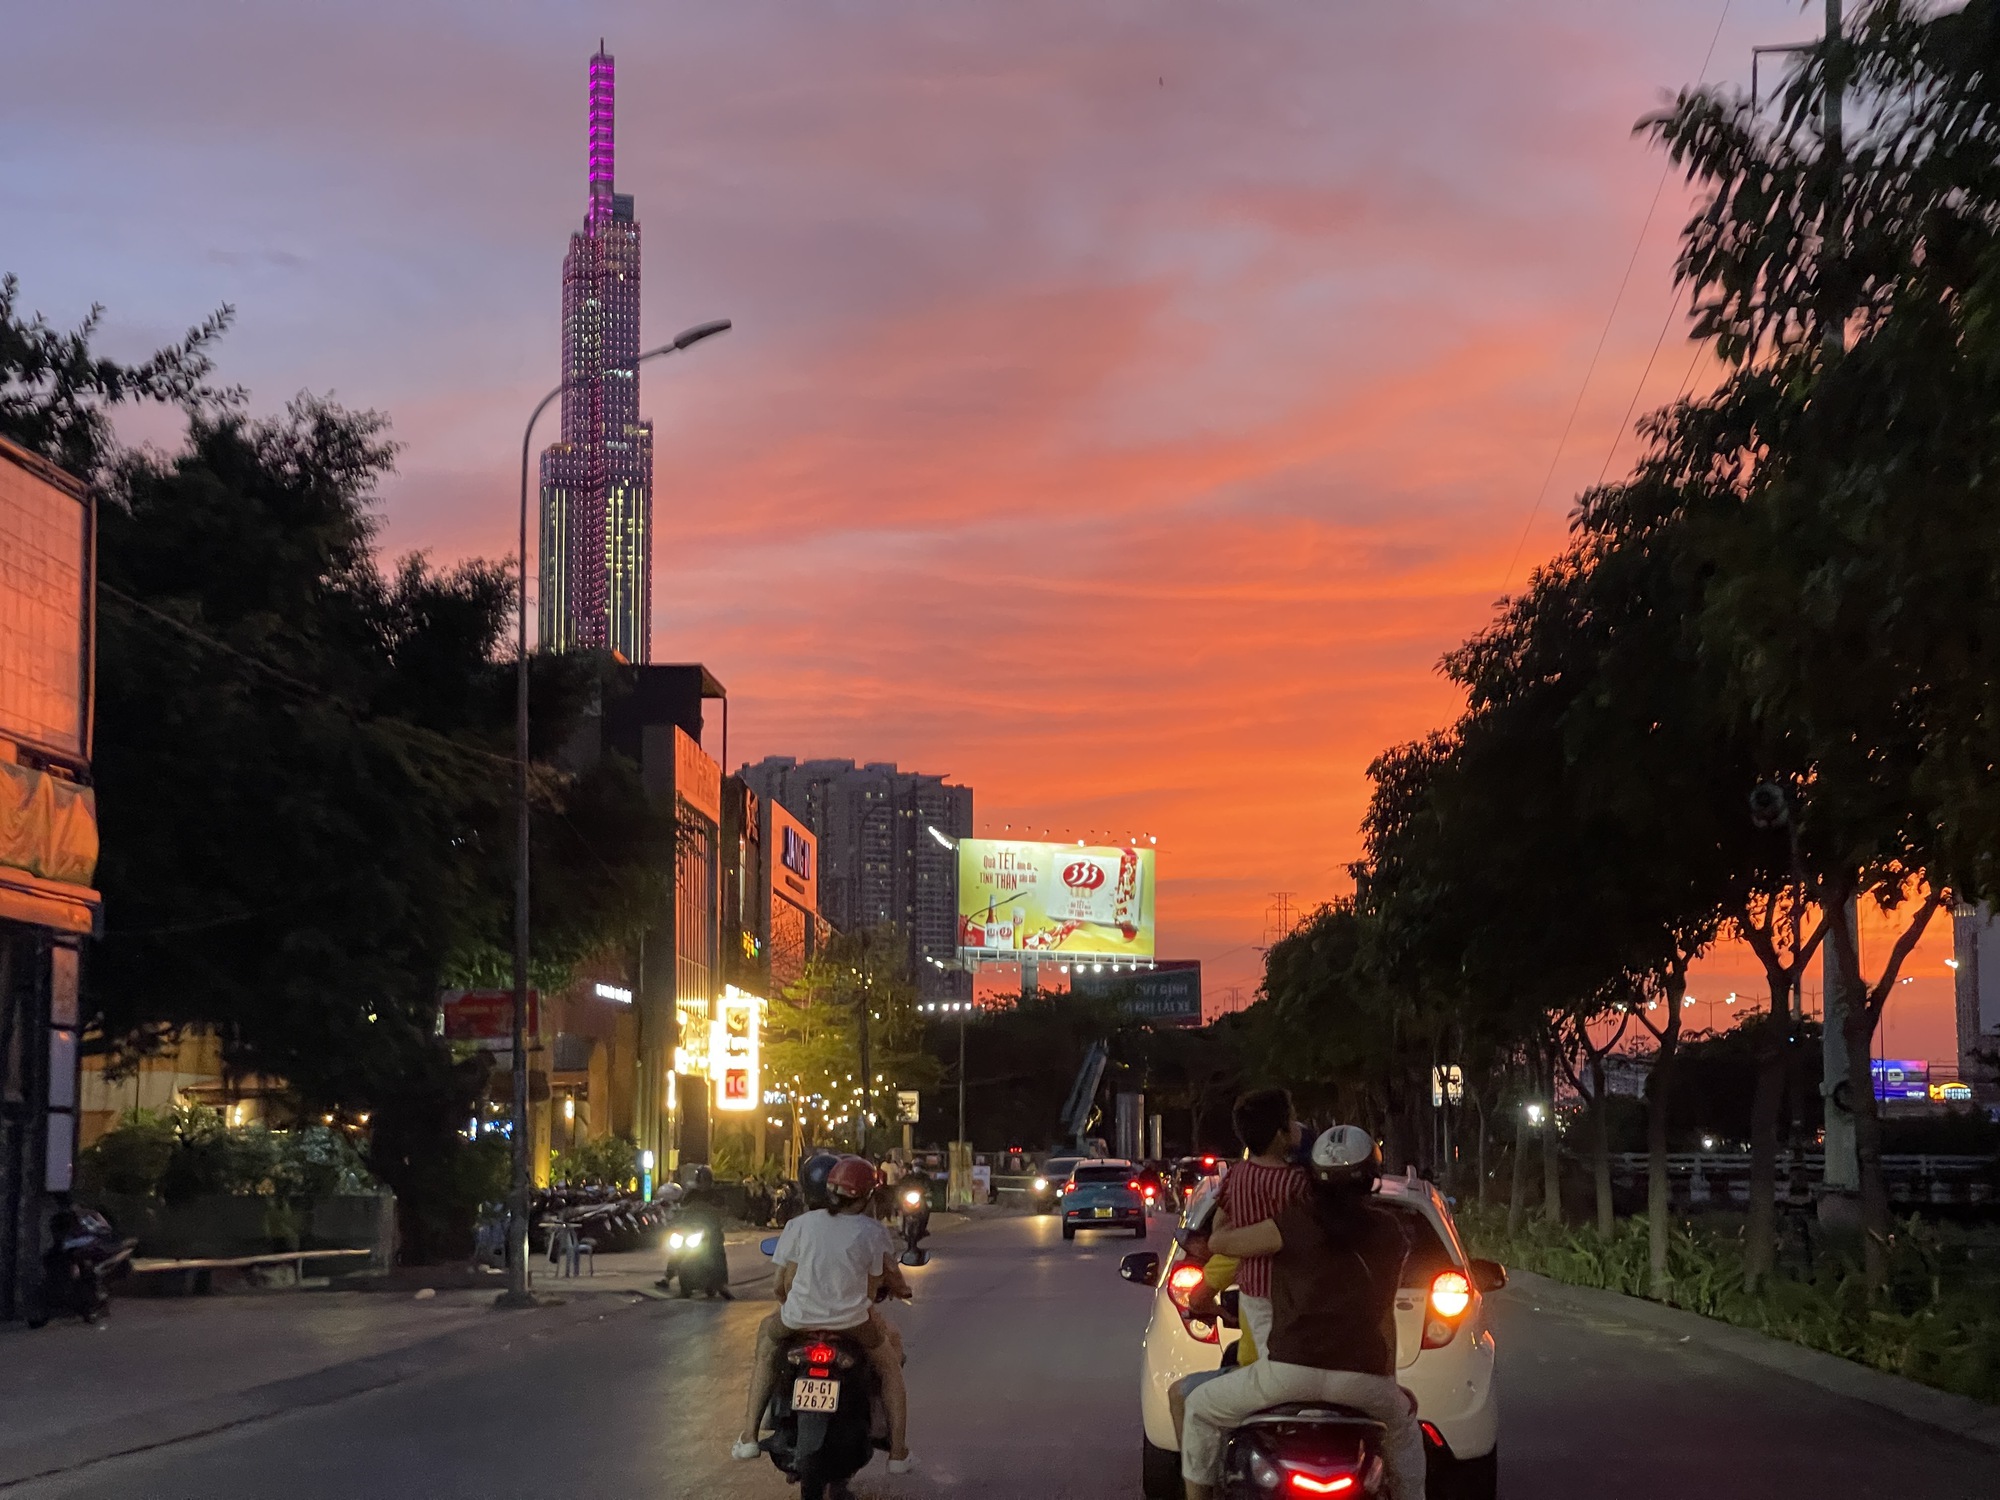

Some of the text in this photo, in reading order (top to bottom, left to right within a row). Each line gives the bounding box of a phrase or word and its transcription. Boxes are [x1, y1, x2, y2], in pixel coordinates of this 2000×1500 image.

[998, 847, 1016, 870] TẾT
[1066, 858, 1098, 886] 333
[801, 1380, 832, 1395] 78-G1
[795, 1394, 835, 1409] 326.73
